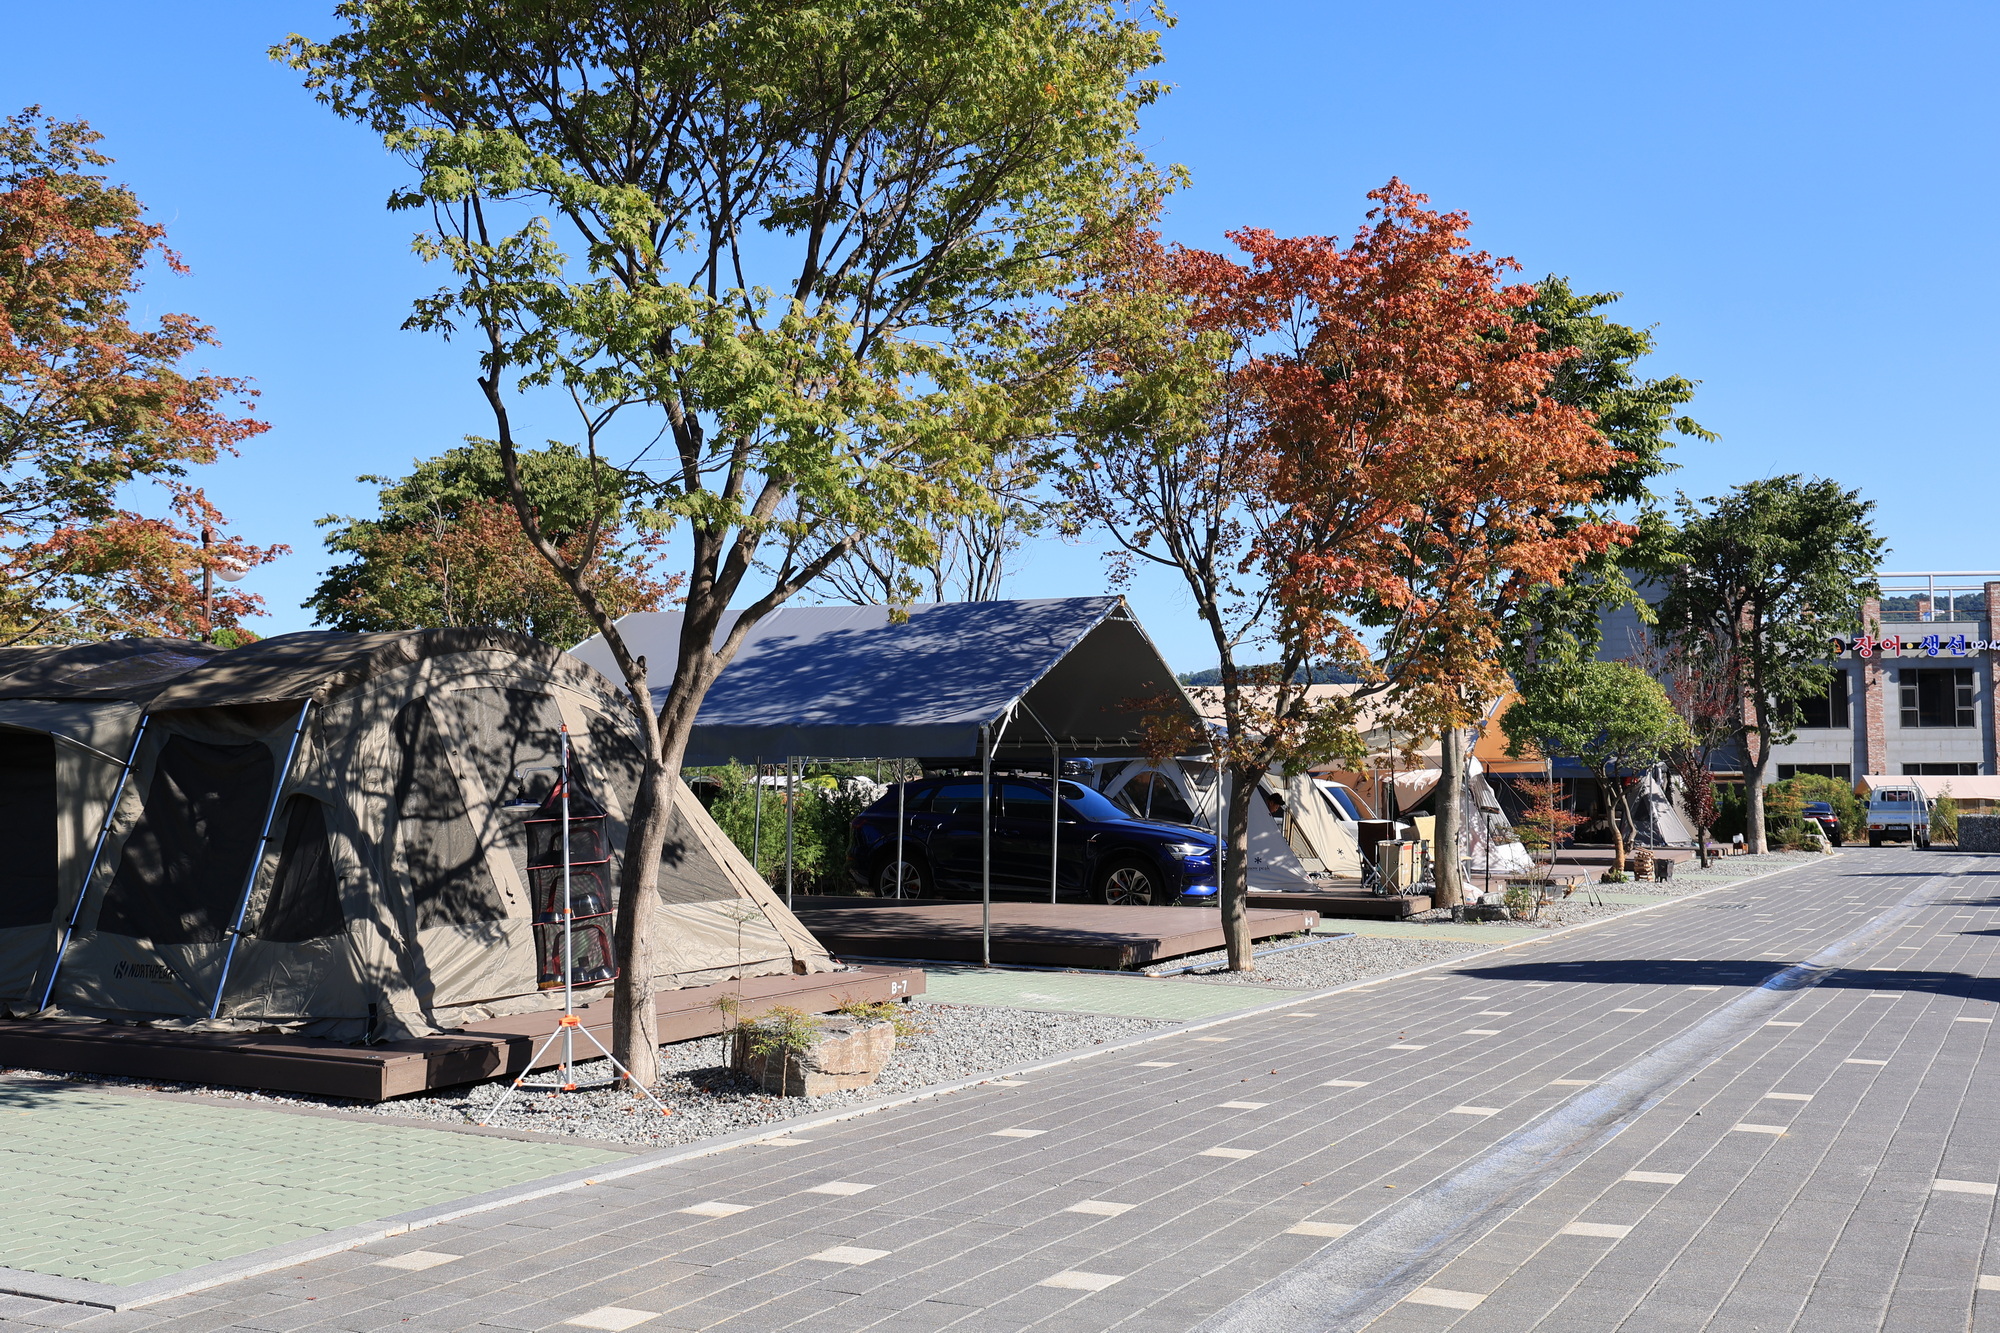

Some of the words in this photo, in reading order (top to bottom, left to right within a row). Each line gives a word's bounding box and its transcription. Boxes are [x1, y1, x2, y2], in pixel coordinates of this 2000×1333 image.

[1852, 635, 1901, 658] 장어
[1919, 634, 1967, 656] 생선
[891, 979, 908, 995] B-7
